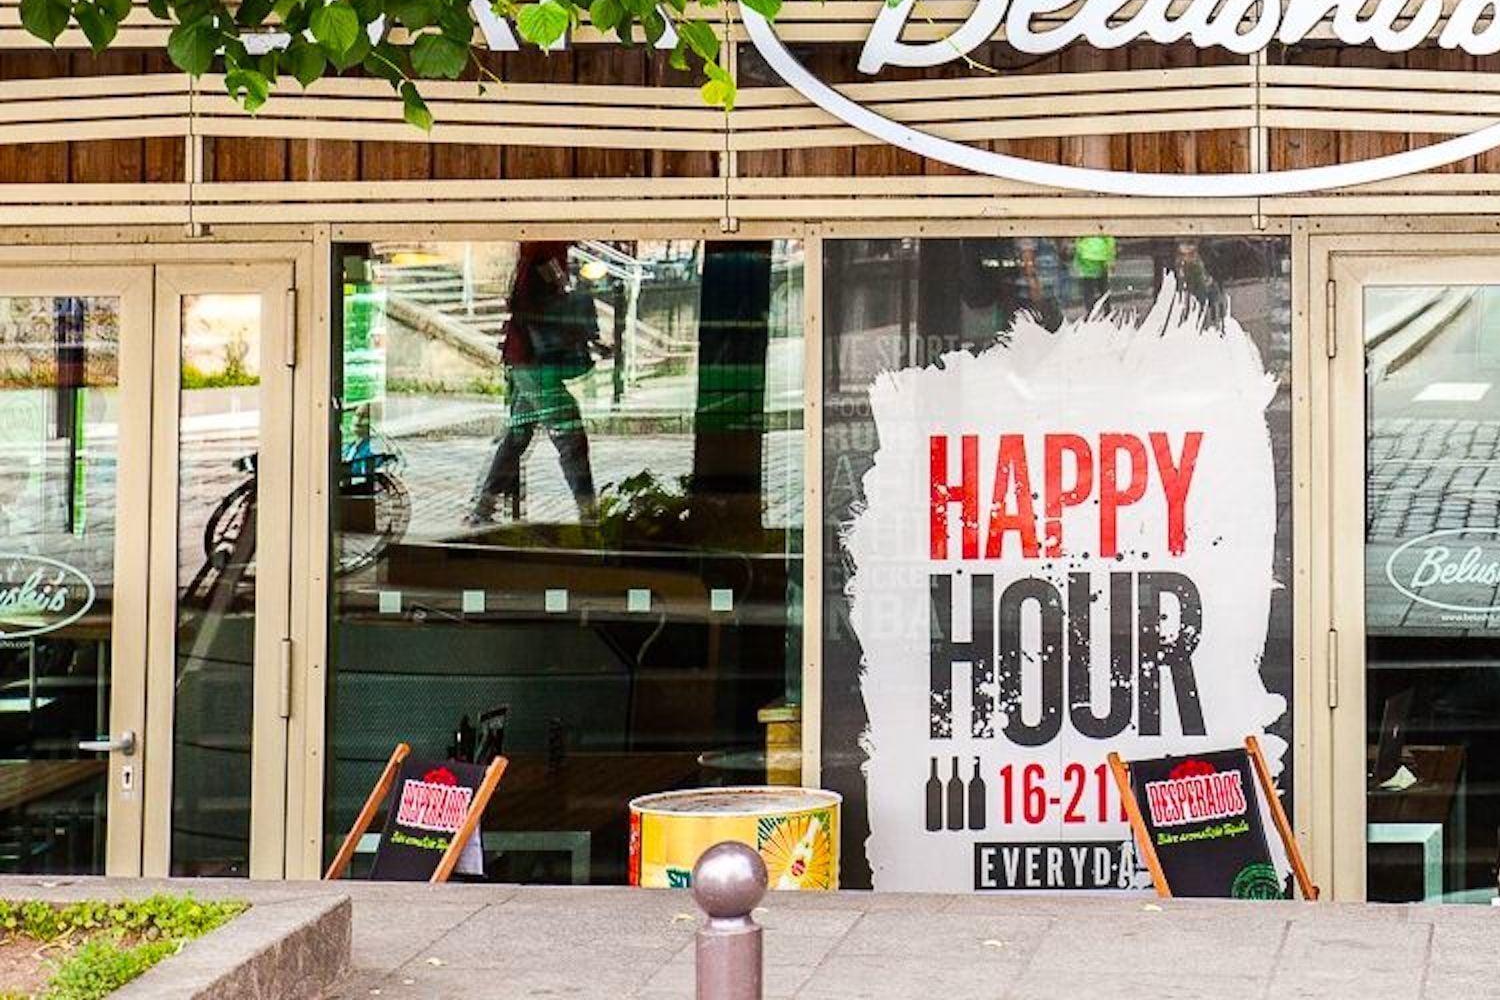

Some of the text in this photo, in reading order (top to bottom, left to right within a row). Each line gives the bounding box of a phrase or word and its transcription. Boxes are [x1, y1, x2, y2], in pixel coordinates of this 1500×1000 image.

[929, 431, 1205, 561] HAPPY
[929, 570, 1207, 747] HOUR
[1000, 763, 1128, 825] 16-21
[1147, 772, 1247, 826] DESPERADOS
[981, 842, 1136, 890] EVERYDA
